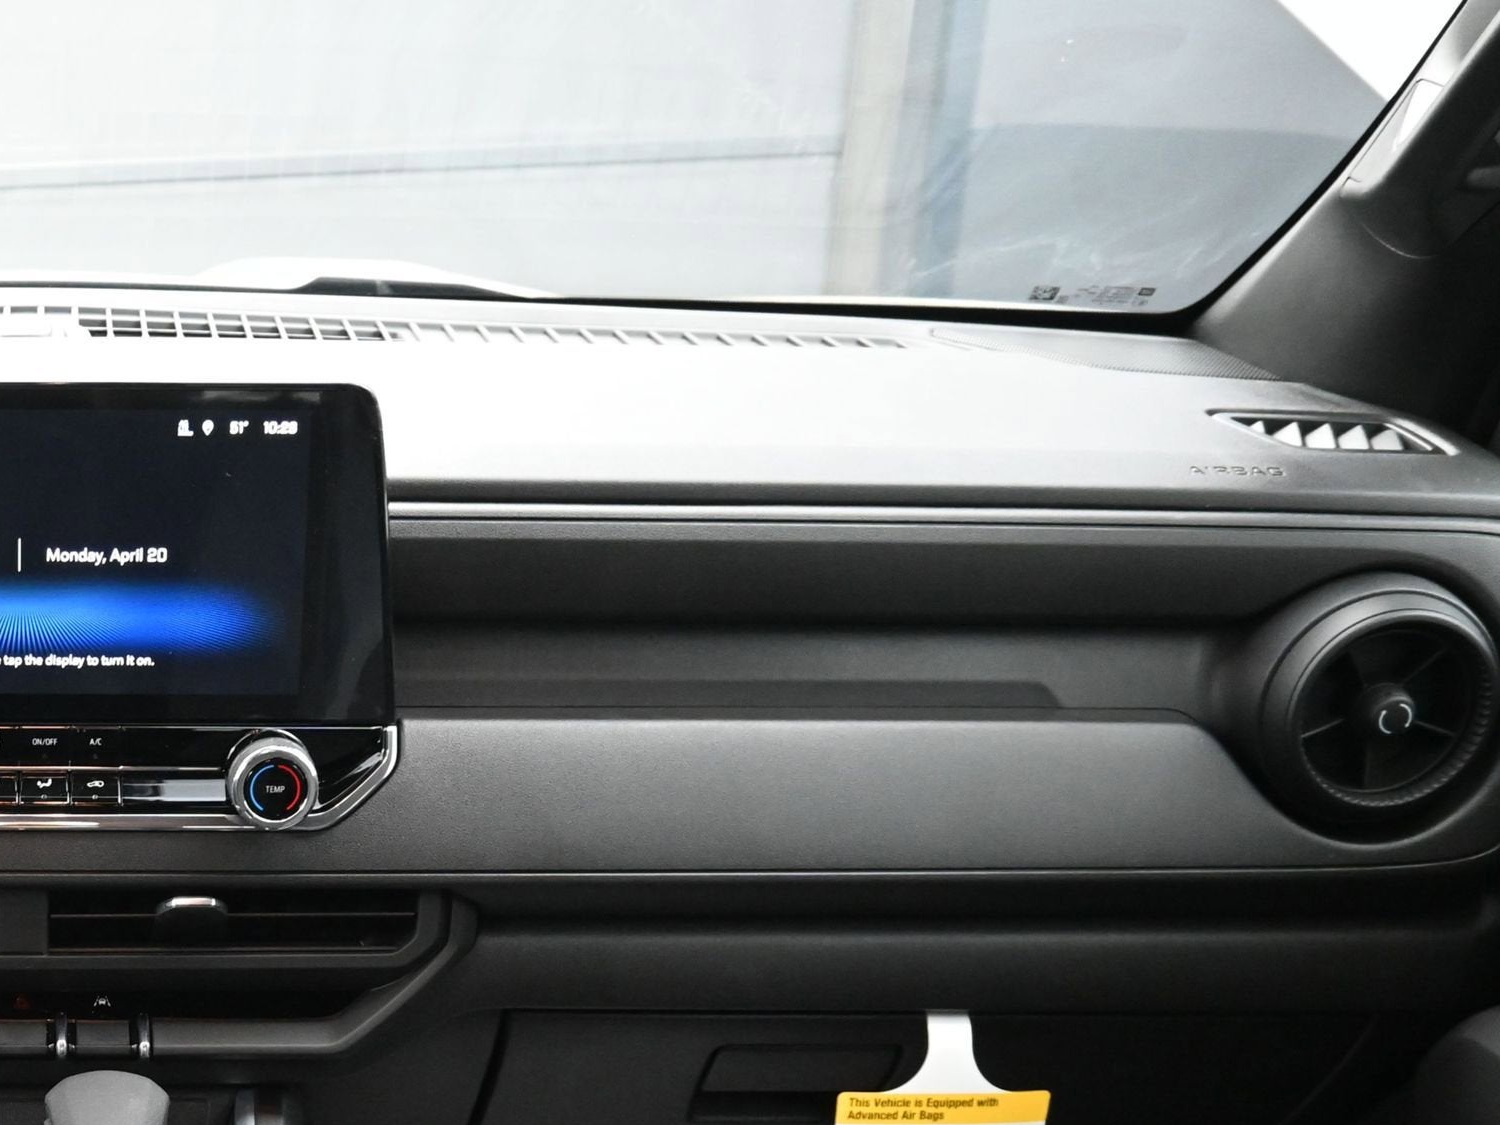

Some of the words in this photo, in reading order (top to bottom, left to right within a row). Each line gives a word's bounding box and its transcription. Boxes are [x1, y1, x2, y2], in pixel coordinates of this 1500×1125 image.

[1190, 465, 1283, 477] AIRBAG
[46, 547, 107, 566] Monday,
[109, 547, 143, 566] April
[147, 547, 168, 562] 20
[3, 655, 22, 668] tap
[24, 653, 43, 666] the
[44, 653, 85, 668] display
[86, 655, 99, 666] to
[100, 655, 124, 666] turn
[126, 653, 135, 666] it
[136, 656, 155, 666] on.
[32, 738, 58, 746] ON/OFF
[89, 737, 102, 746] A/C
[265, 785, 286, 794] TEMP
[850, 1097, 870, 1108] This
[874, 1097, 911, 1108] Vehicle
[914, 1097, 923, 1108] is
[926, 1097, 974, 1109] Equipped
[977, 1097, 999, 1107] with
[847, 1110, 899, 1120] Advanced
[901, 1110, 916, 1120] Air
[919, 1110, 945, 1122] Bags
